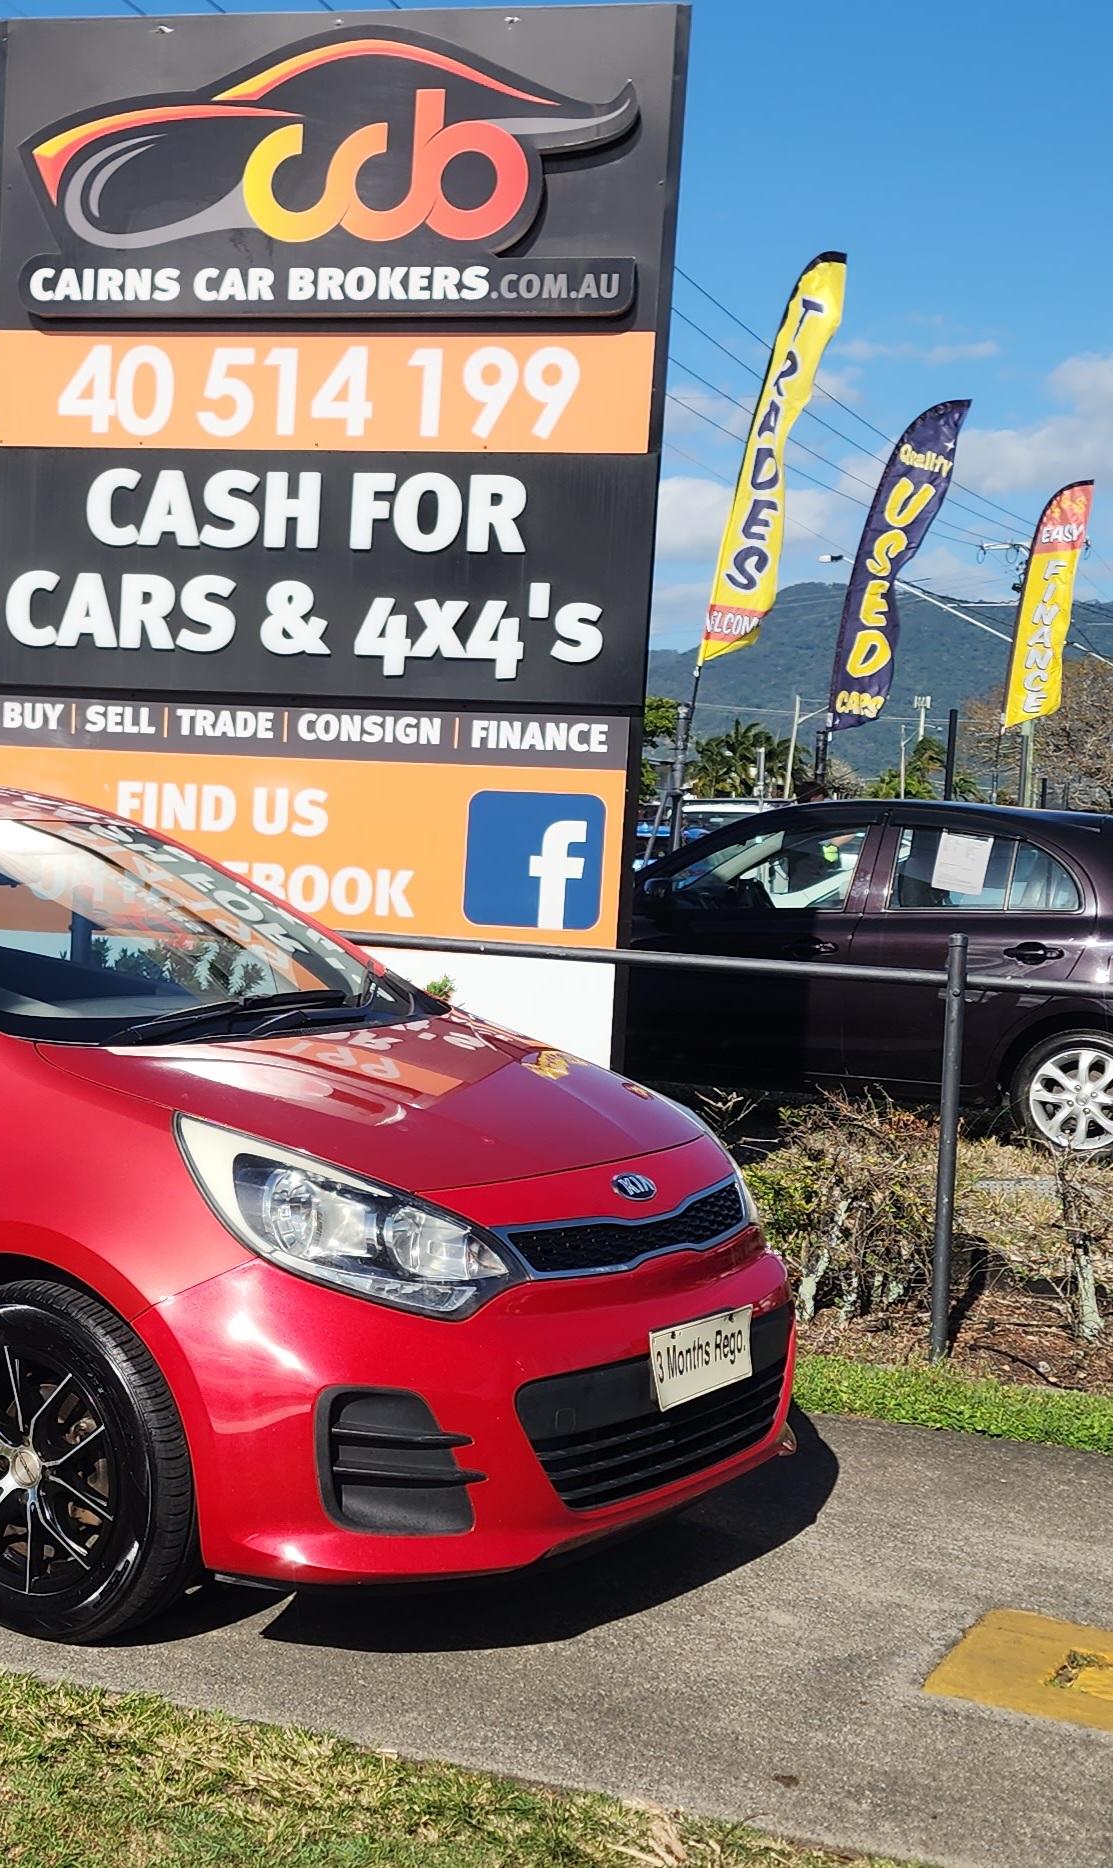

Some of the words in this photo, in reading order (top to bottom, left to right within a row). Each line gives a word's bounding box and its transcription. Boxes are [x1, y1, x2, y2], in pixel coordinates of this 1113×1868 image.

[29, 267, 181, 302] CAIRNS
[192, 267, 275, 302] CAR
[56, 344, 175, 437] 40
[195, 345, 374, 438] 514
[407, 345, 581, 440] 199
[725, 297, 824, 592] TRADES
[86, 467, 322, 549] CASH
[349, 471, 527, 553] FOR
[1041, 523, 1085, 544] EASY
[845, 476, 937, 679] USED
[5, 569, 237, 652] CARS
[259, 580, 331, 655] &
[706, 610, 760, 636] ELCOM
[1022, 559, 1068, 714] FINANCE
[2, 700, 65, 731] BUY
[83, 704, 157, 735] SELL
[175, 708, 275, 739] TRADE
[296, 712, 442, 745] CONSIGN
[470, 719, 609, 753] FINANCE
[836, 690, 886, 718] CARS
[114, 780, 237, 834] FIND
[252, 785, 329, 837] US
[618, 1176, 655, 1195] KIA
[655, 1350, 666, 1384] 3
[667, 1336, 711, 1378] Months
[714, 1329, 747, 1365] Rego.
